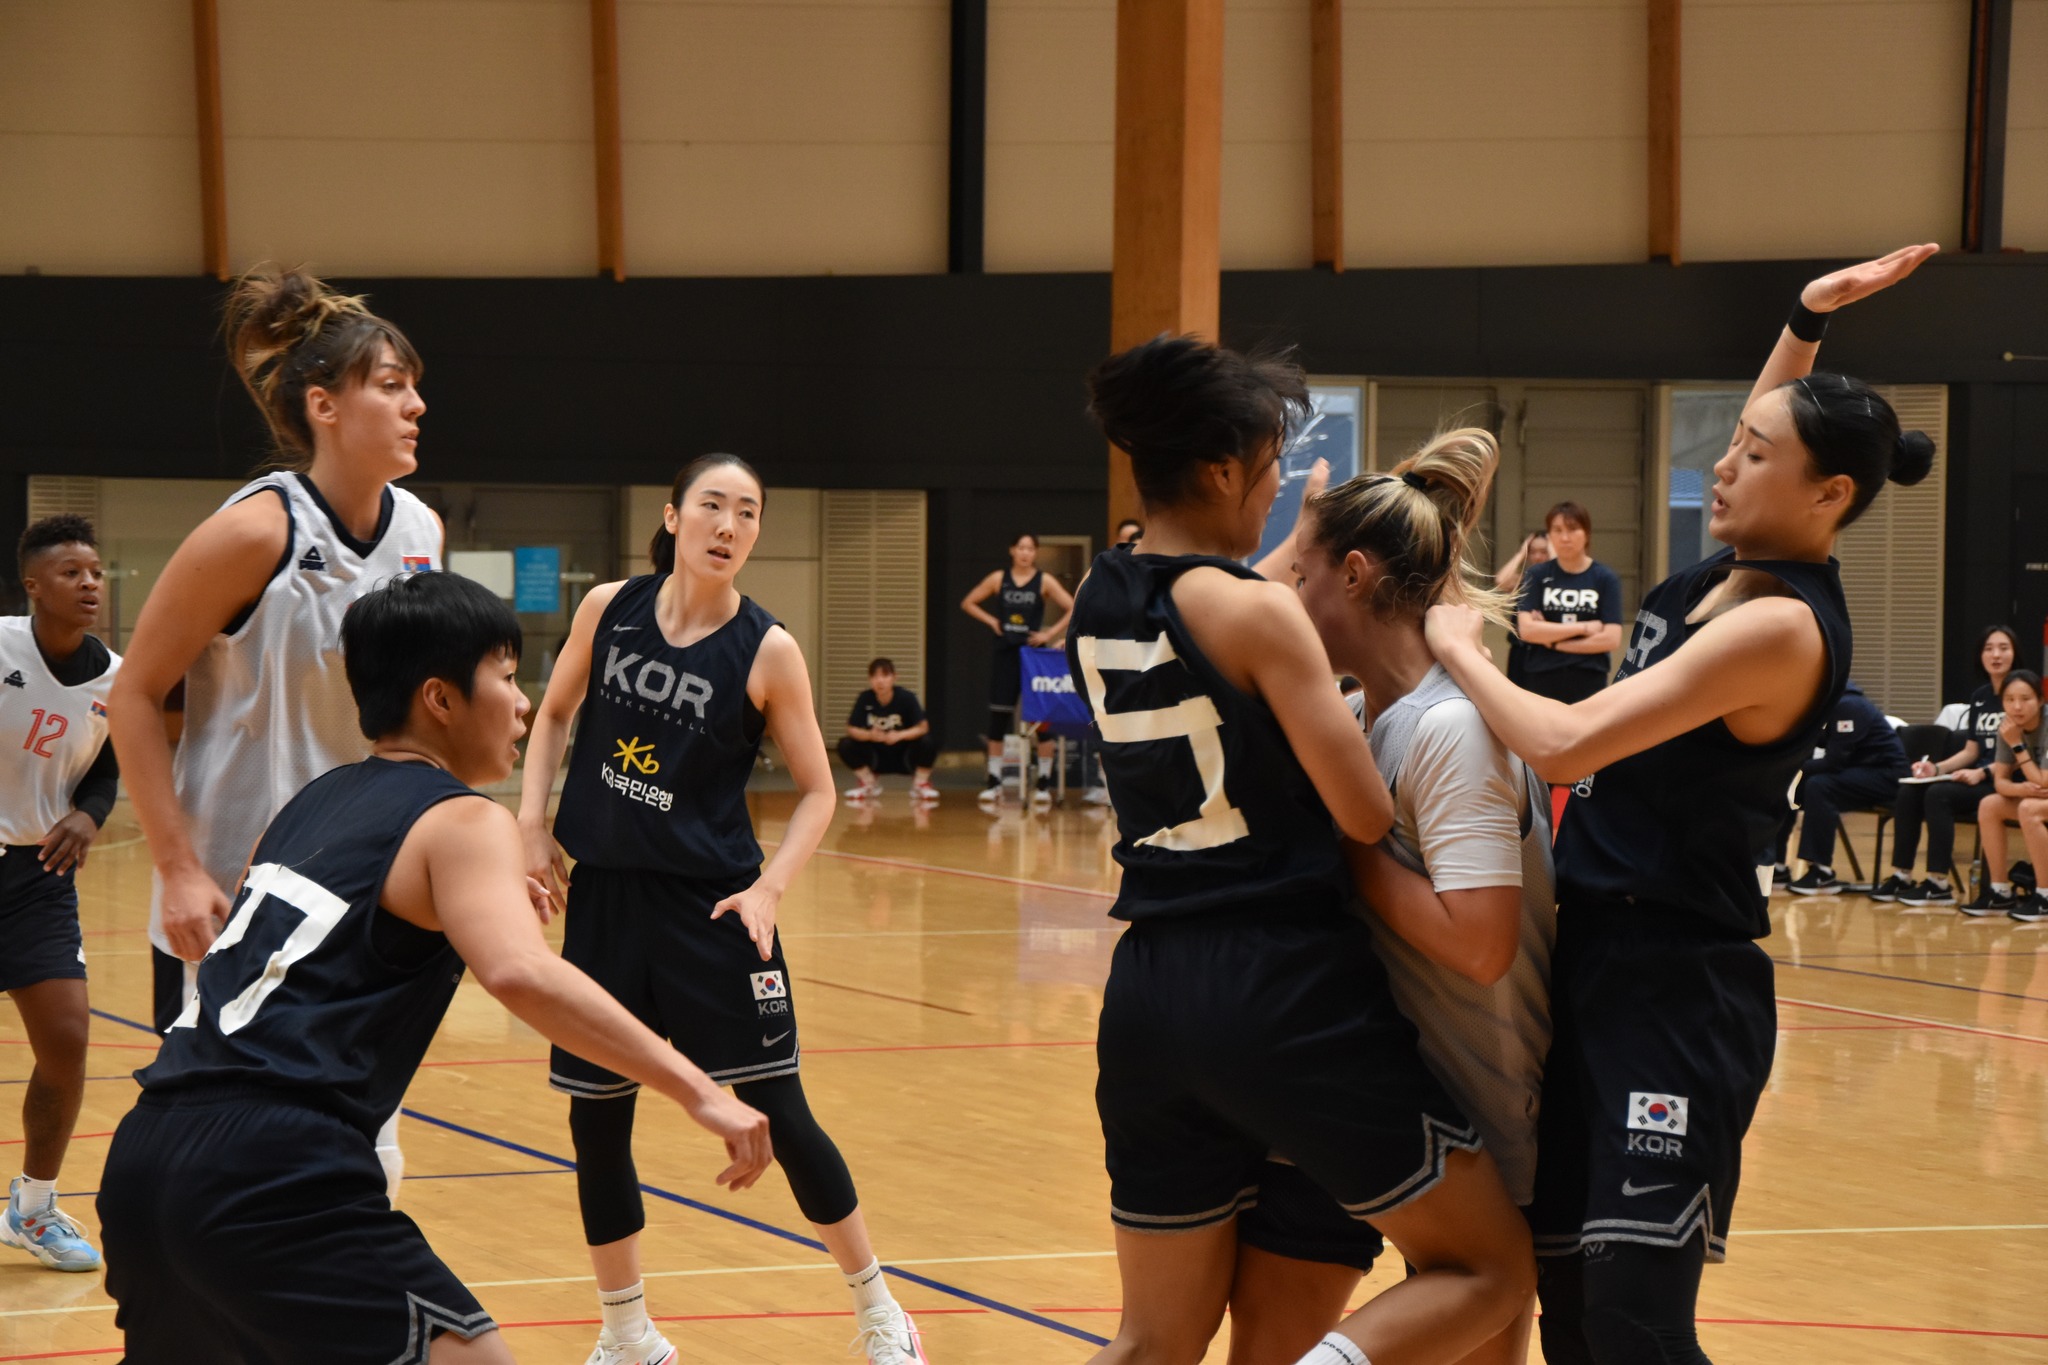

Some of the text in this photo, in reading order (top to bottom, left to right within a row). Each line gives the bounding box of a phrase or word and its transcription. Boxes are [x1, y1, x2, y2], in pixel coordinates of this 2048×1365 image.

[1543, 586, 1600, 609] KOR
[603, 644, 714, 719] KOR
[23, 708, 69, 759] 12
[1077, 630, 1250, 852] 5
[601, 762, 674, 812] KB국민은행
[758, 1000, 788, 1016] KOR
[1627, 1132, 1684, 1158] KOR
